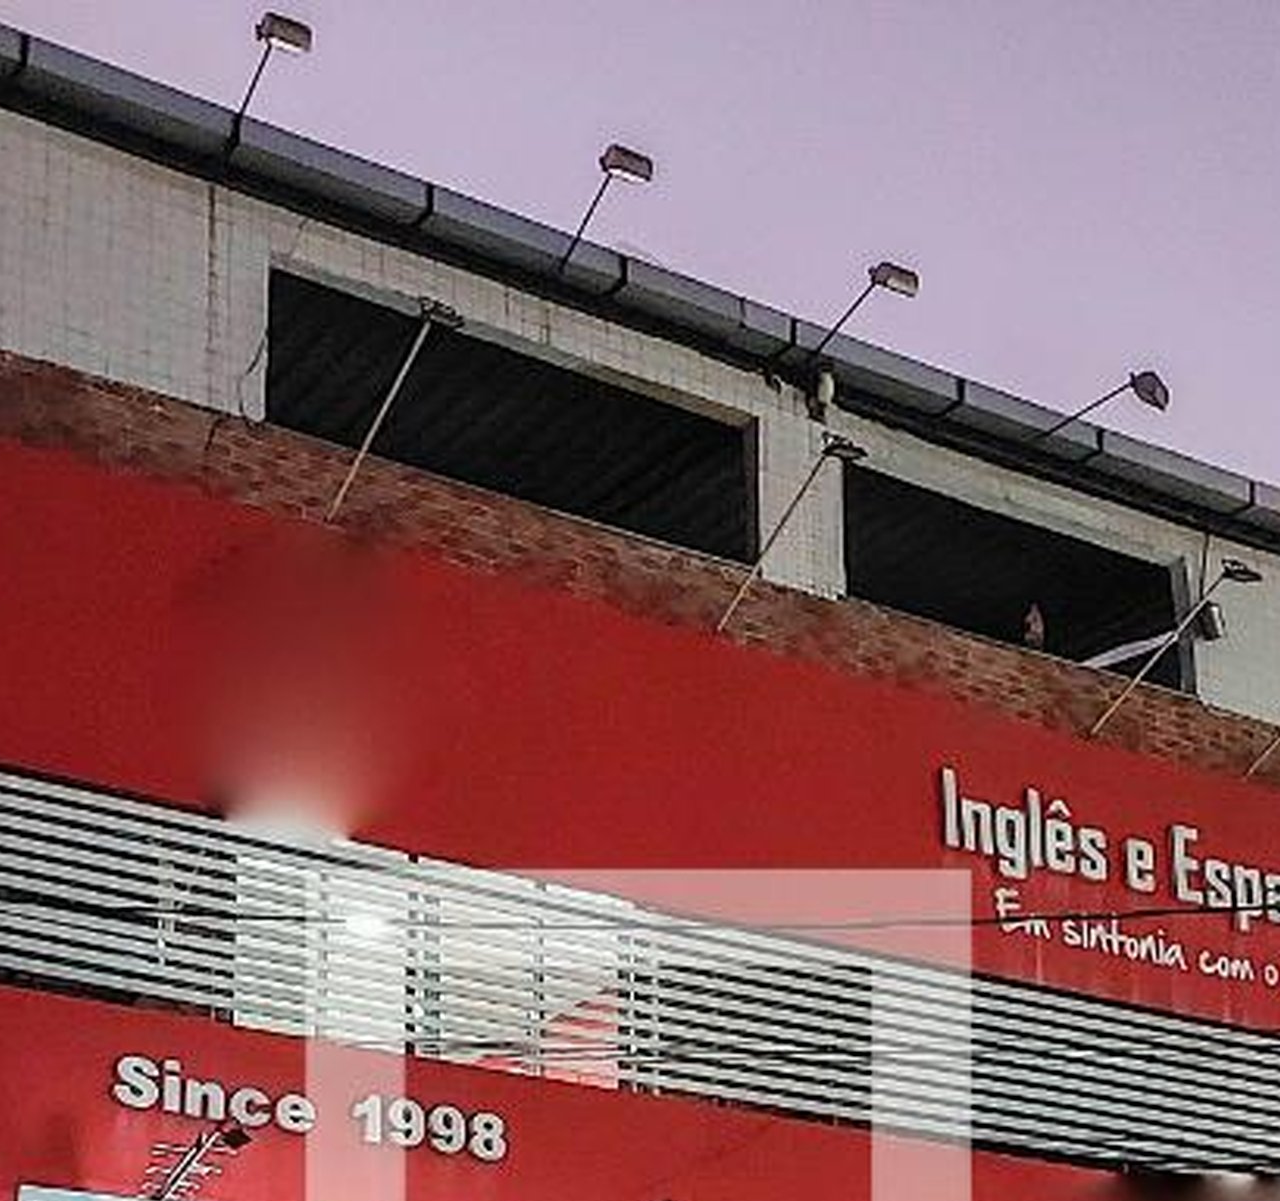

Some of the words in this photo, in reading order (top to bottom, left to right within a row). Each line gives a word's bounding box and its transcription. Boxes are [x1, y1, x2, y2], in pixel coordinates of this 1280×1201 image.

[940, 767, 1108, 882] Inglês
[1124, 836, 1157, 893] e
[994, 886, 1052, 940] Em
[1063, 912, 1188, 974] sintonia
[1198, 948, 1256, 982] com
[1263, 964, 1280, 987] o
[111, 1055, 318, 1134] Since
[351, 1094, 509, 1162] 1998
